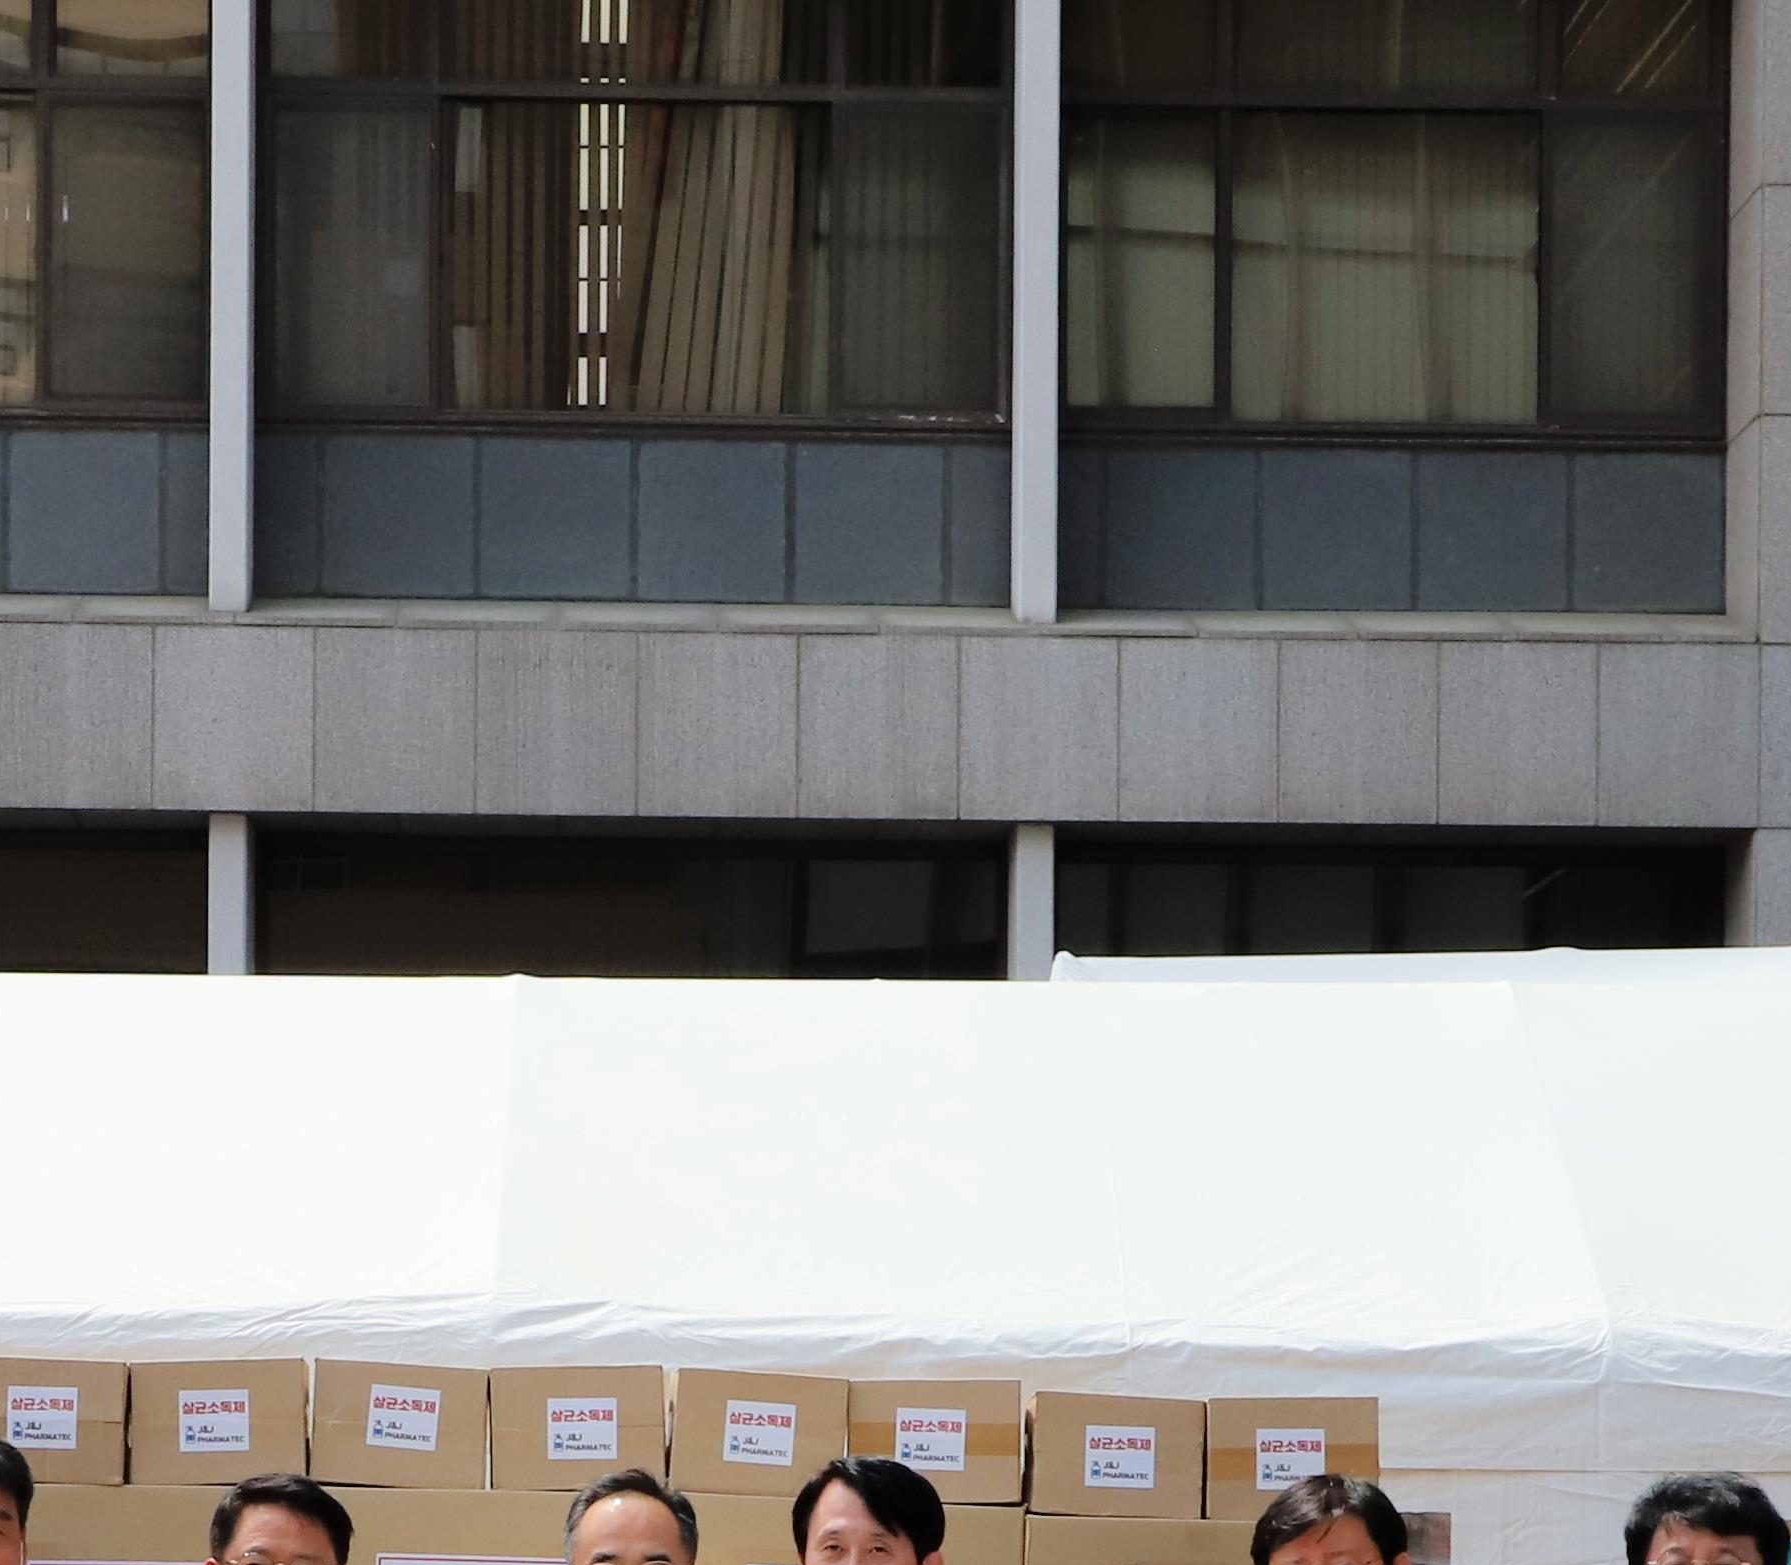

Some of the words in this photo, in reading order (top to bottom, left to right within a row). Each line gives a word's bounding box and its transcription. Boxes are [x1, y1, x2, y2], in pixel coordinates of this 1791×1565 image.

[11, 1398, 74, 1411] 살균소독제
[183, 1401, 245, 1414] 살균소독제
[373, 1396, 436, 1413] 살균소독제
[551, 1409, 613, 1422] 살균소독제
[729, 1412, 792, 1428] 살균소독제
[900, 1419, 963, 1433] 살균소독제
[24, 1432, 72, 1441] PHARMATEC
[197, 1435, 245, 1443] PHARMATEC
[384, 1432, 432, 1443] PHARMATEC
[565, 1444, 612, 1452] PHARMATEC
[1089, 1437, 1152, 1451] 살균소독제
[1260, 1440, 1322, 1453] 살균소독제
[741, 1448, 789, 1458] PHARMATEC
[912, 1455, 959, 1463] PHARMATEC
[1102, 1472, 1150, 1481] PHARMATEC
